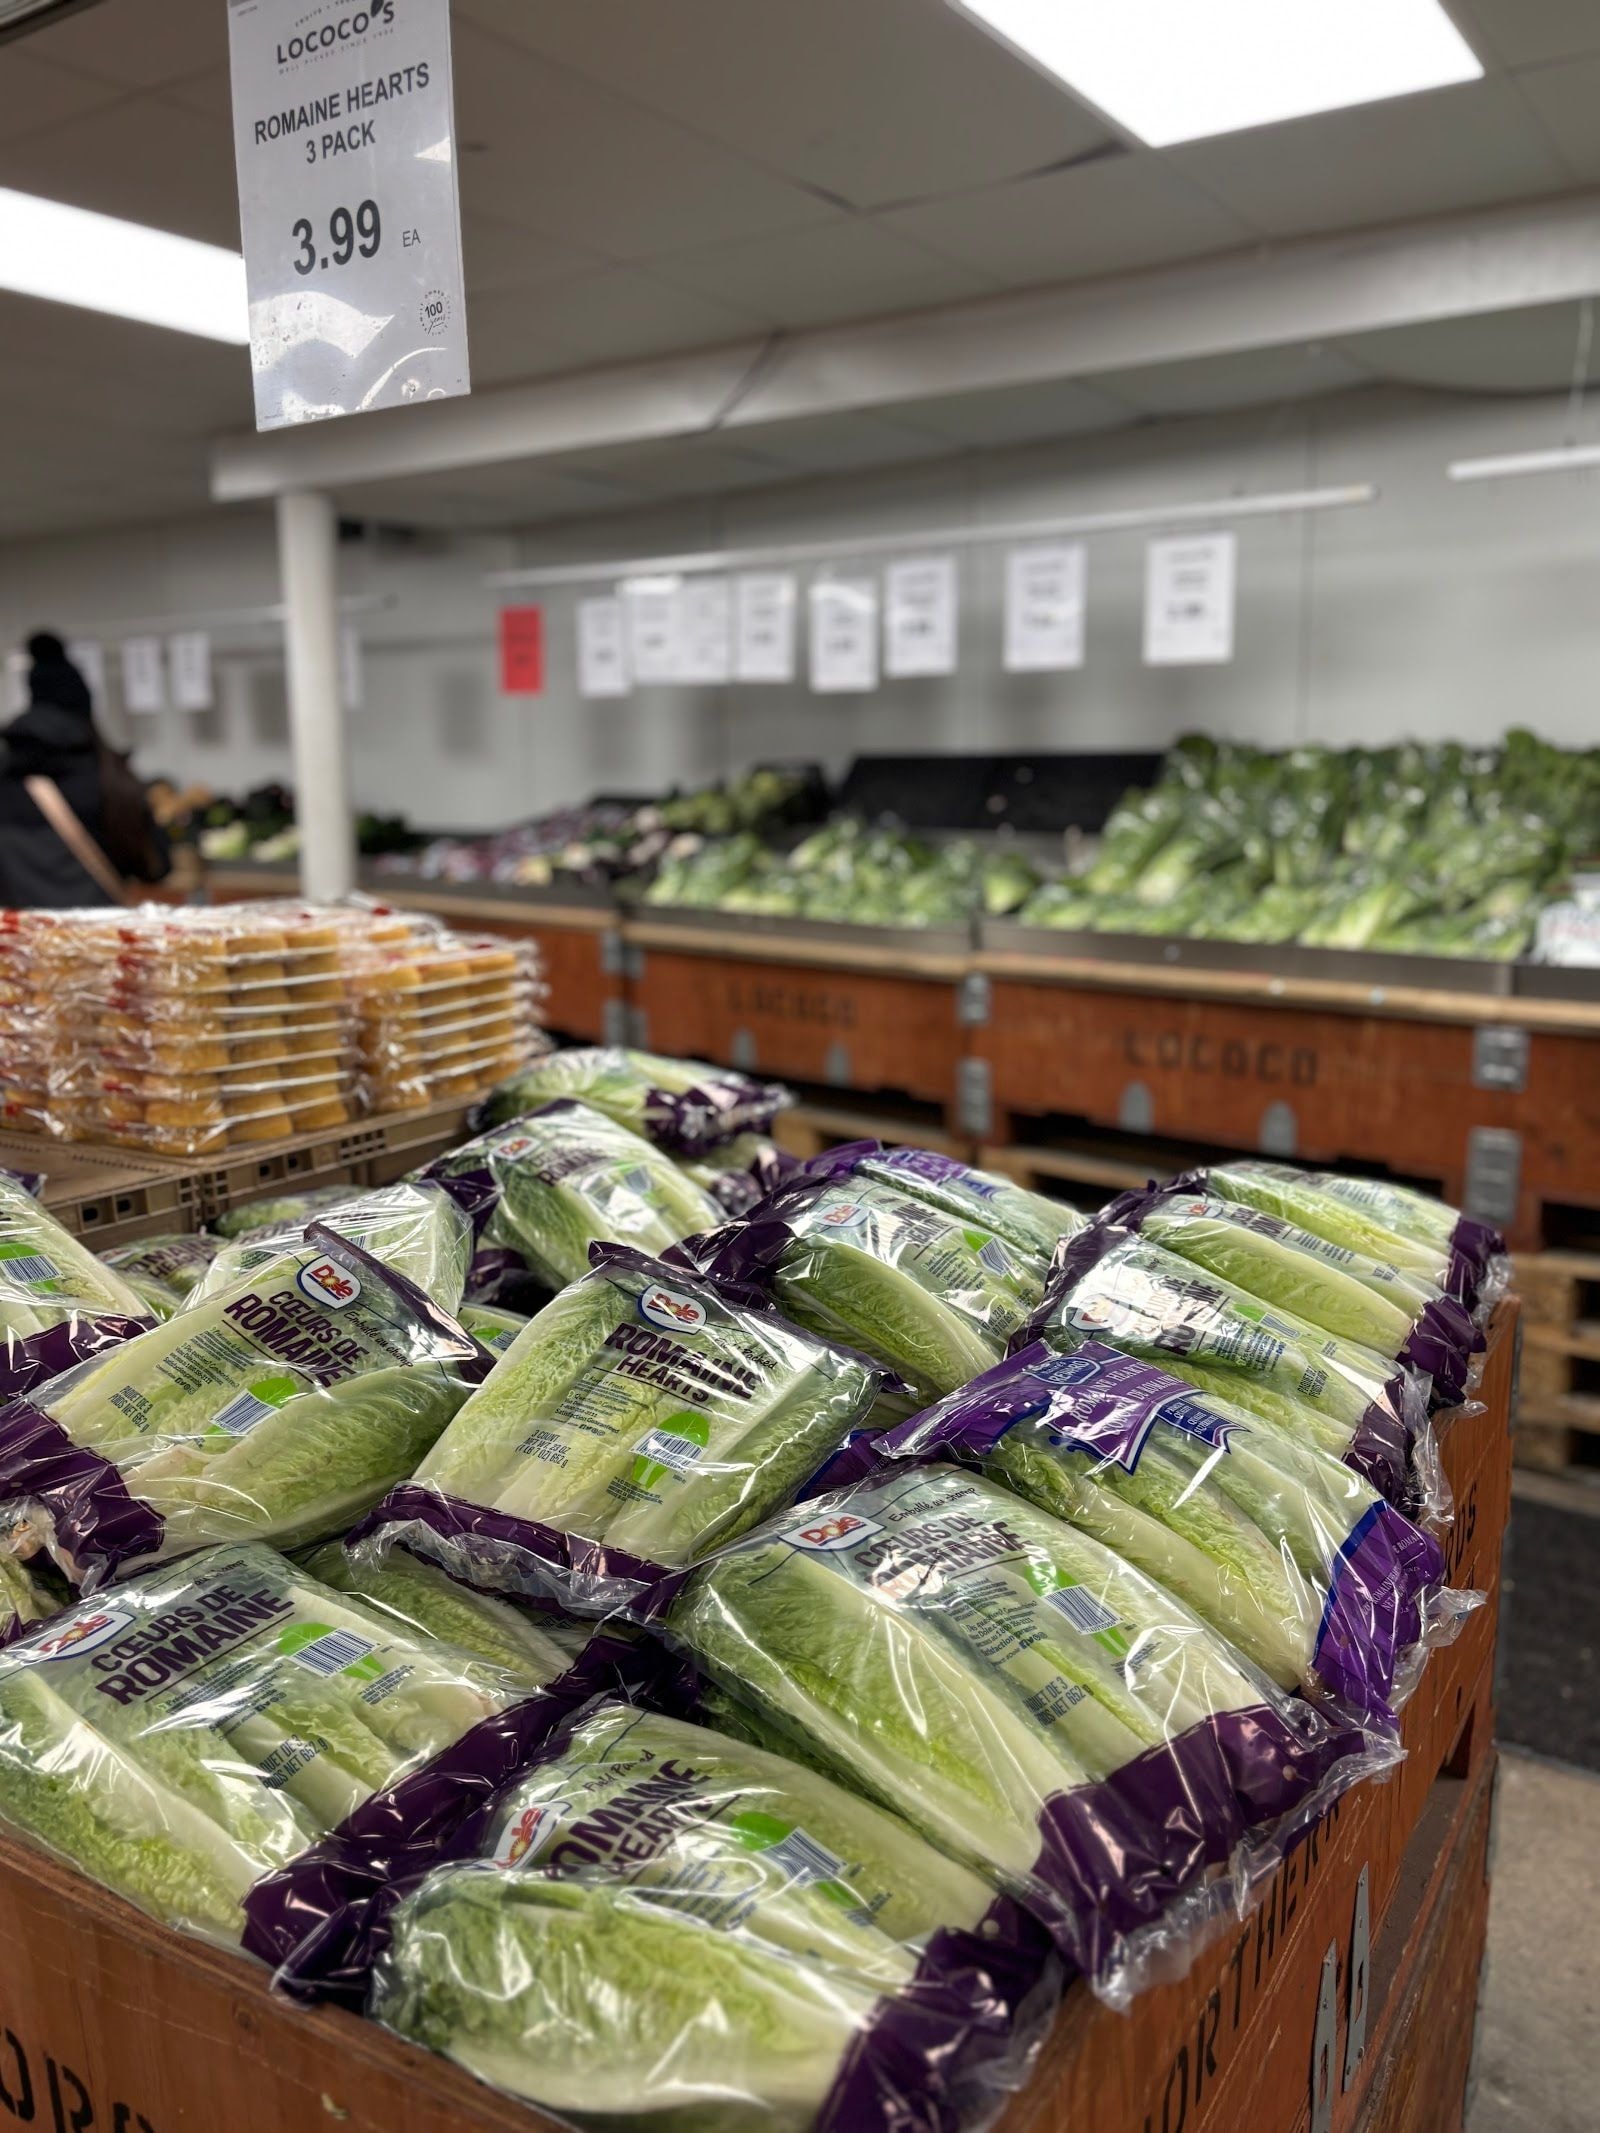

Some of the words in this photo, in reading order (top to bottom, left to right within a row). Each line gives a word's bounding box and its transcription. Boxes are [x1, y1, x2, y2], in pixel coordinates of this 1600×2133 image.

[254, 92, 342, 145] ROMAINE
[346, 62, 431, 114] HEARTS
[305, 139, 317, 164] 3
[321, 119, 376, 160] PACK
[291, 199, 382, 276] 3.99
[402, 229, 421, 248] EA
[424, 300, 443, 319] 100
[1121, 1023, 1321, 1088] LOCOCO
[823, 1204, 859, 1225] Dole
[310, 1264, 354, 1300] Dole
[648, 1292, 701, 1323] Dole
[223, 1293, 357, 1389] ROMAINE
[268, 1291, 342, 1344] CŒURS
[330, 1338, 370, 1366] DE
[343, 1310, 379, 1342] Emballé
[374, 1337, 391, 1349] au
[385, 1342, 414, 1369] champ
[603, 1322, 762, 1400] ROMAINE
[616, 1355, 711, 1403] HEARTS
[1048, 1360, 1090, 1383] REWARD
[121, 1403, 138, 1418] NET
[131, 1412, 148, 1428] 652
[537, 1431, 561, 1443] COUNT
[558, 1445, 572, 1455] OZ
[549, 1453, 566, 1465] 652
[799, 1514, 864, 1546] Dole
[888, 1500, 935, 1522] Emballé
[854, 1522, 946, 1568] CŒURS
[940, 1511, 986, 1533] DE
[863, 1521, 1033, 1599] ROMAINE
[38, 1614, 111, 1655] Dole
[90, 1605, 206, 1673] CŒURS
[196, 1584, 246, 1613] DE
[95, 1588, 296, 1706] ROMAINE
[1045, 1681, 1063, 1698] DE
[1056, 1676, 1069, 1690] 3
[1050, 1697, 1071, 1718] NET
[1065, 1685, 1087, 1706] 652
[1081, 1683, 1095, 1696] g
[256, 1749, 284, 1774] QUET
[280, 1739, 297, 1757] DE
[291, 1733, 303, 1747] 3
[283, 1754, 304, 1777] NET
[300, 1740, 321, 1762] 652
[317, 1737, 329, 1751] g
